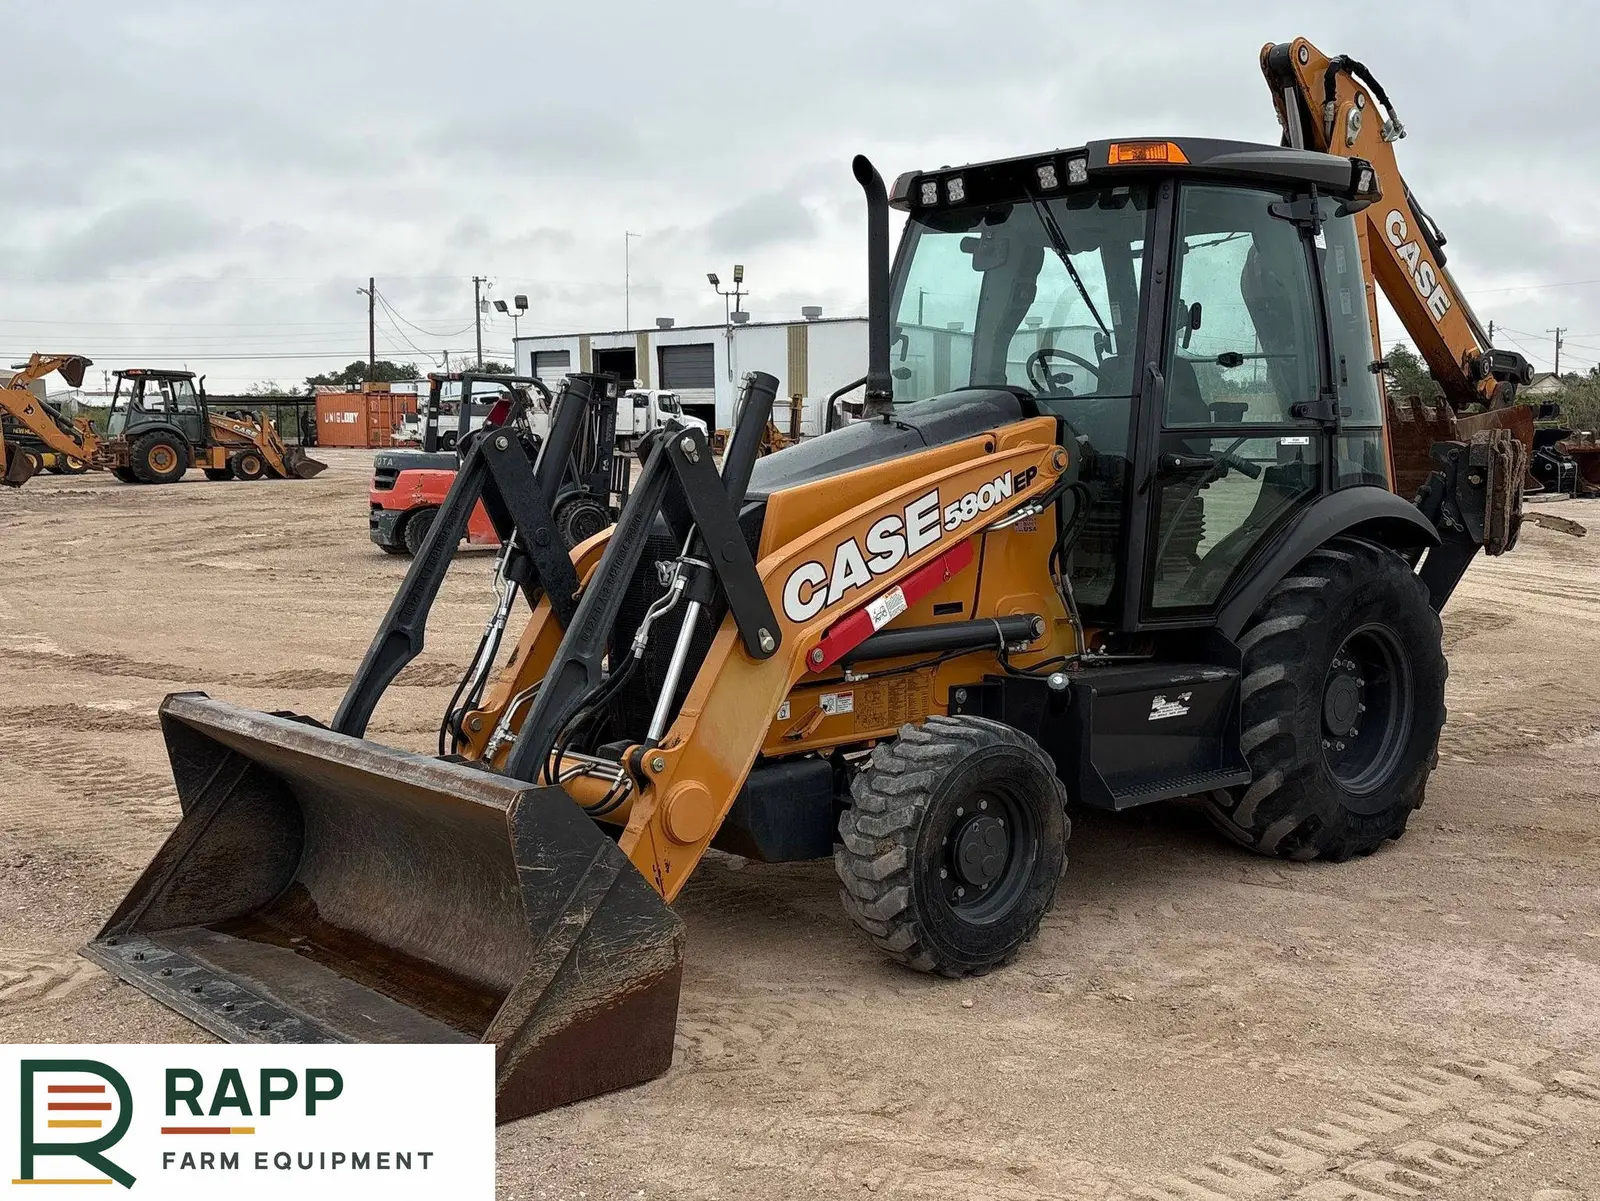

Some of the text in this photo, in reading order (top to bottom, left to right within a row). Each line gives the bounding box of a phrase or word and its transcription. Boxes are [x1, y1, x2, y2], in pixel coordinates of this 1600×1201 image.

[1385, 209, 1452, 324] CASE
[783, 487, 942, 623] CASE
[943, 470, 1012, 531] 580N
[1013, 465, 1038, 494] EP
